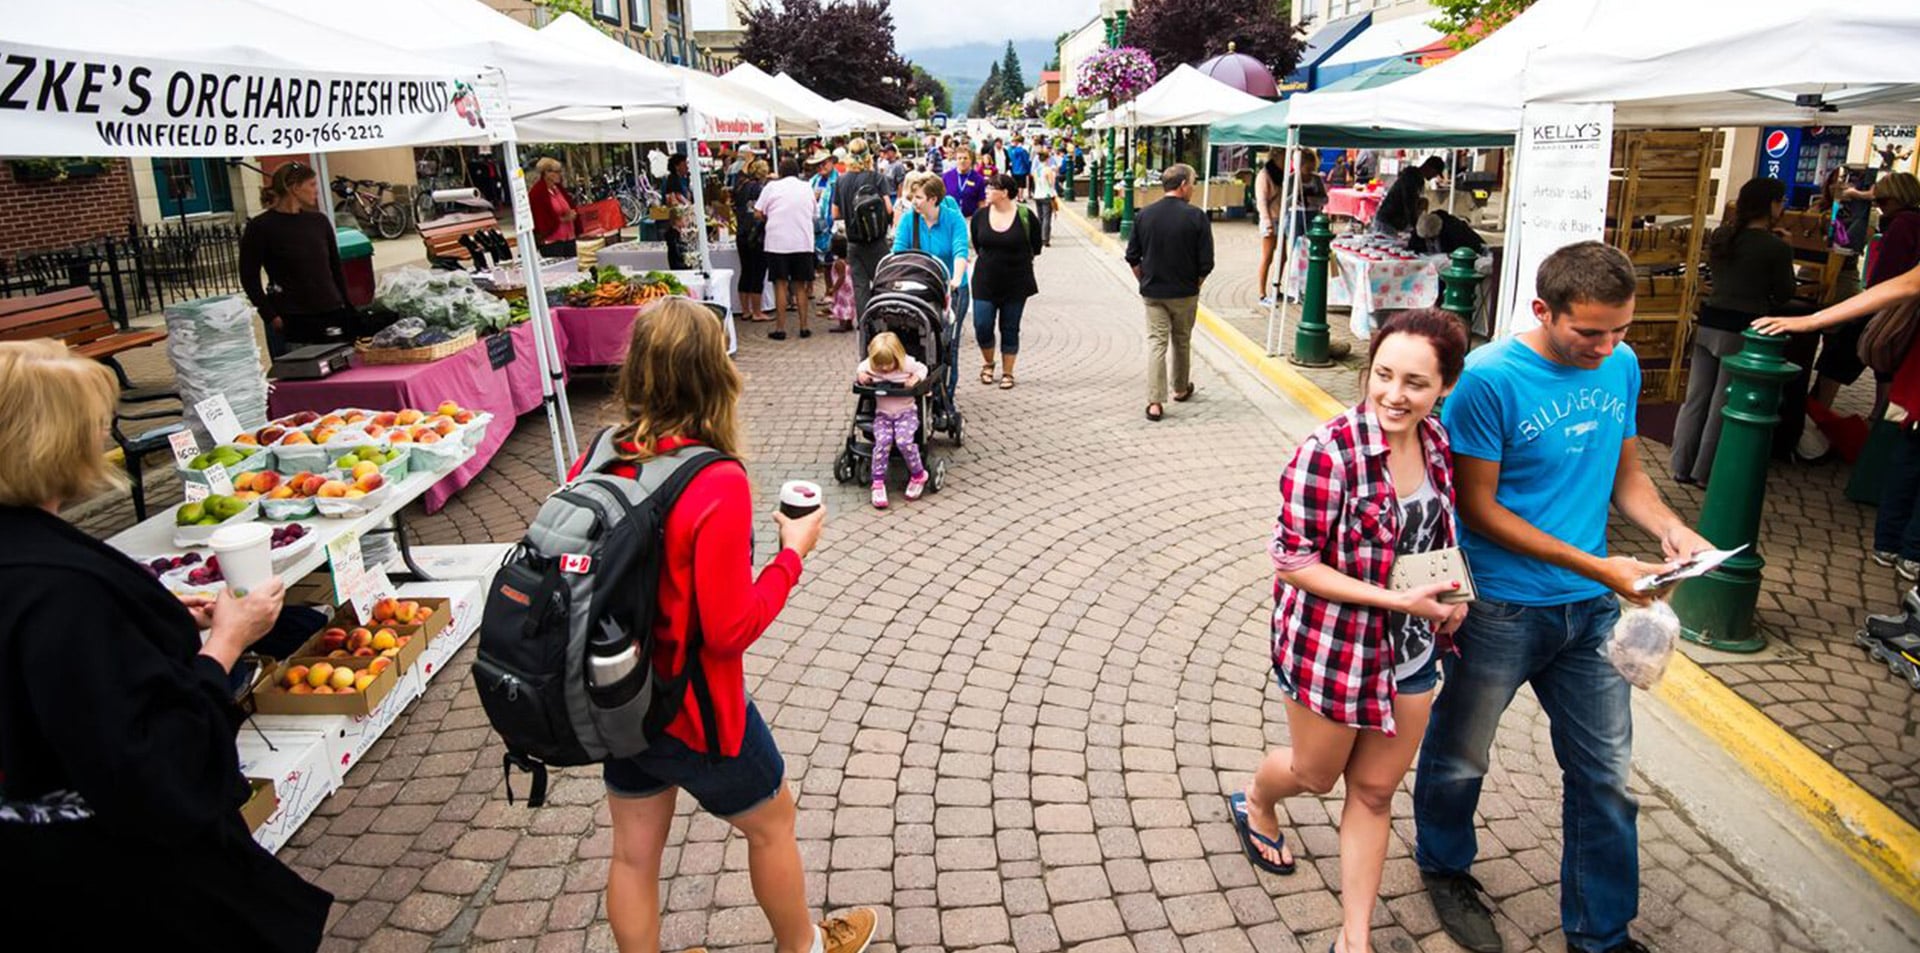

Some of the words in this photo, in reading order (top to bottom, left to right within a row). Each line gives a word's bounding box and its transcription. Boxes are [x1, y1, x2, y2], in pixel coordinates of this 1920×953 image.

[0, 53, 152, 116] ZKE'S
[166, 70, 322, 118] ORCHARD
[327, 80, 392, 117] FRESH
[398, 80, 449, 113] FRUIT
[96, 120, 218, 147] WINFIELD
[224, 123, 265, 147] B.C.
[271, 121, 385, 149] 250-766-2212
[1533, 122, 1601, 140] KELLY'S
[1518, 388, 1626, 442] BILLABONG
